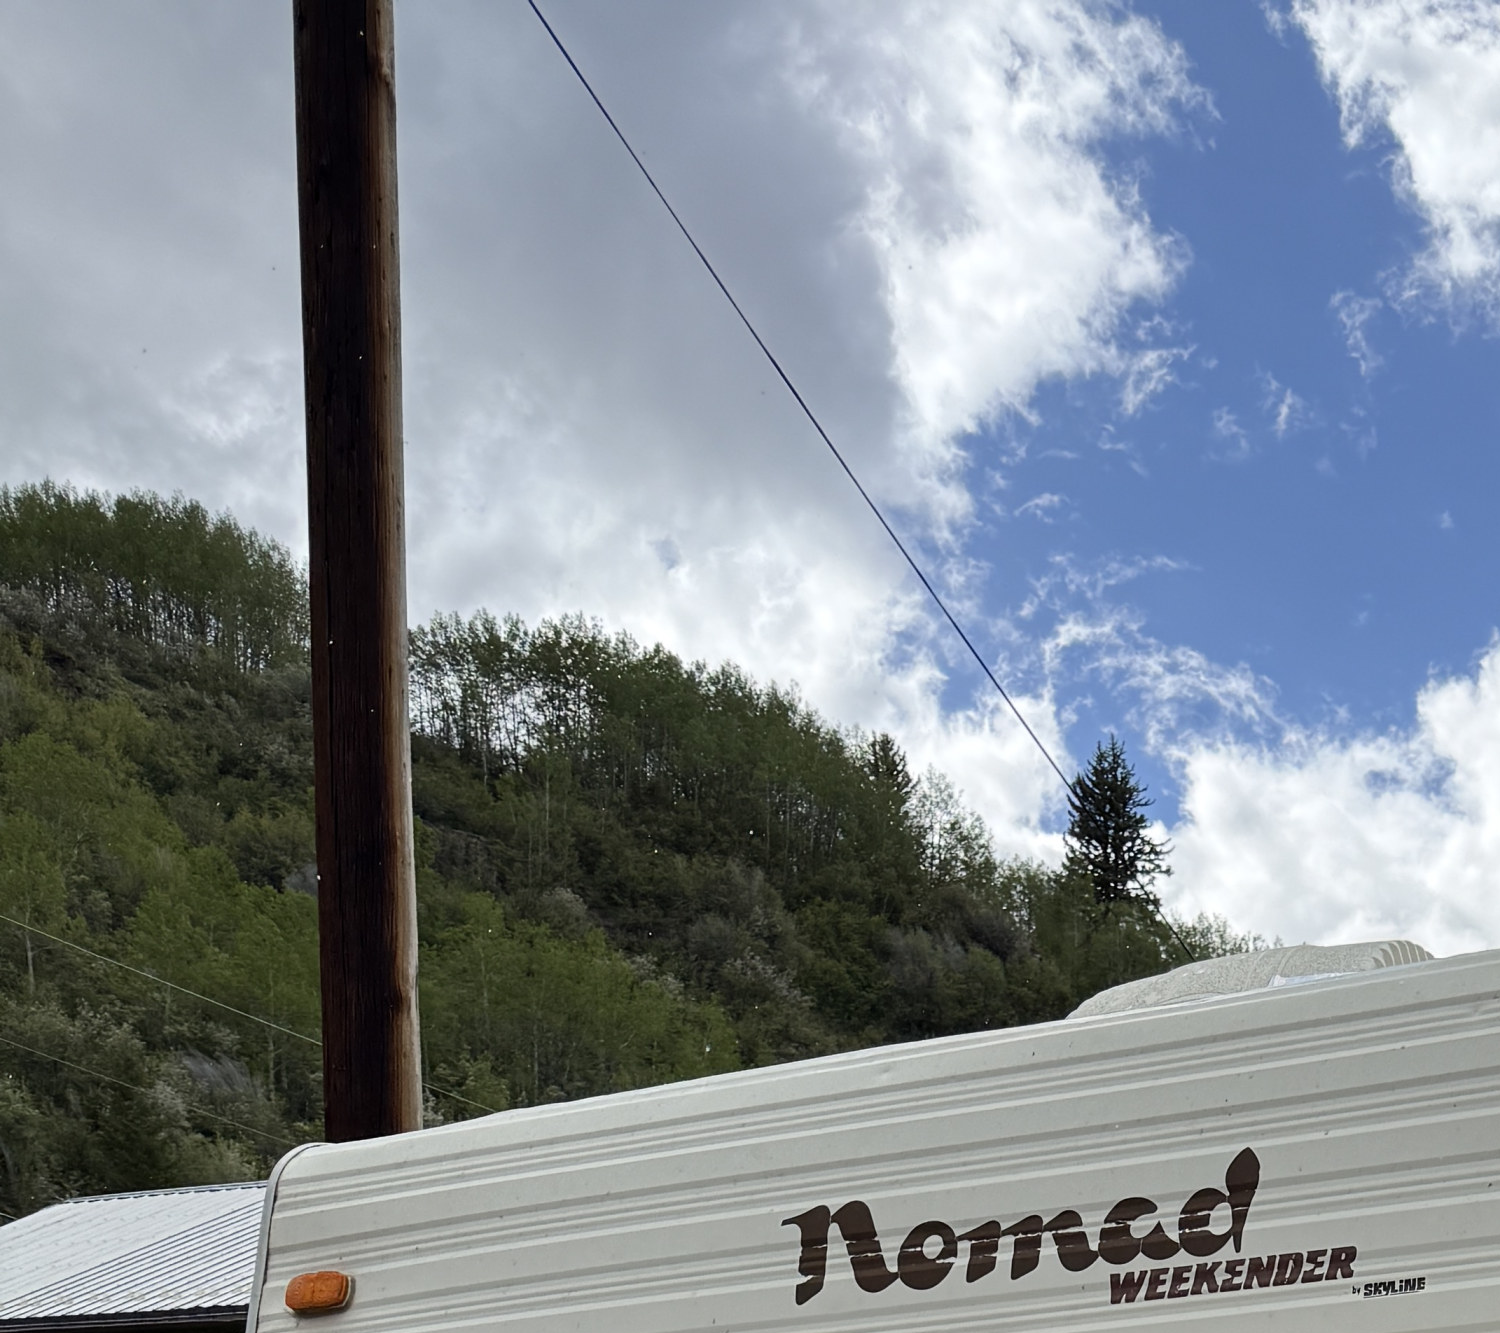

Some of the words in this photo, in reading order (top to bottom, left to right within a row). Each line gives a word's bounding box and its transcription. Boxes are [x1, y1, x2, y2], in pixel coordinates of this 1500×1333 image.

[780, 1146, 1261, 1306] Nomad
[1110, 1245, 1358, 1305] WEEKENDER
[1352, 1286, 1361, 1296] by
